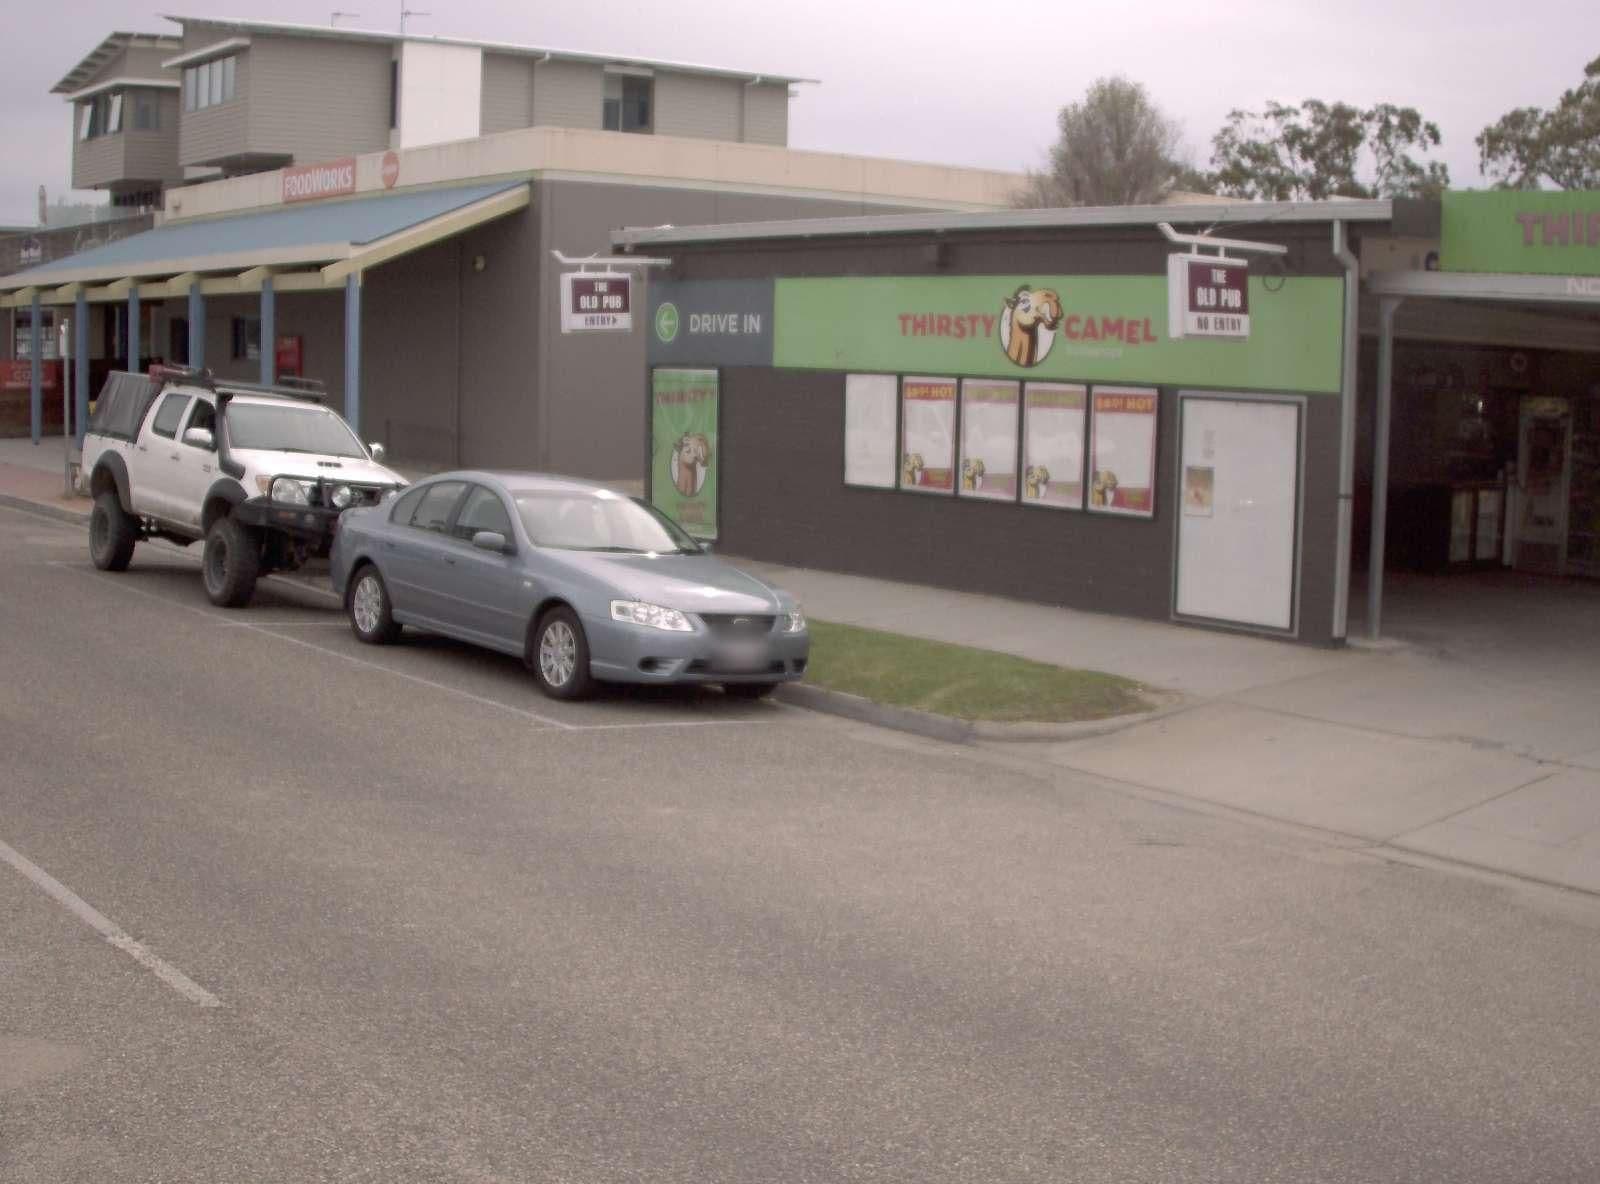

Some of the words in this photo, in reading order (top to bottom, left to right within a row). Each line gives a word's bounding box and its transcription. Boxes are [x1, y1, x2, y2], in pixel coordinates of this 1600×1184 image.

[1211, 268, 1227, 284] THE
[594, 282, 608, 293] THE
[580, 295, 598, 309] OLD
[602, 295, 622, 309] PUB
[1197, 287, 1217, 306] OLD
[1221, 289, 1242, 308] PUB
[585, 315, 610, 326] ENTRY
[689, 313, 738, 333] DRIVE
[743, 313, 762, 335] IN
[898, 311, 994, 340] THIRSTY
[1064, 314, 1157, 344] CAMEL
[1197, 316, 1209, 330] NO
[1214, 317, 1242, 332] ENTRY
